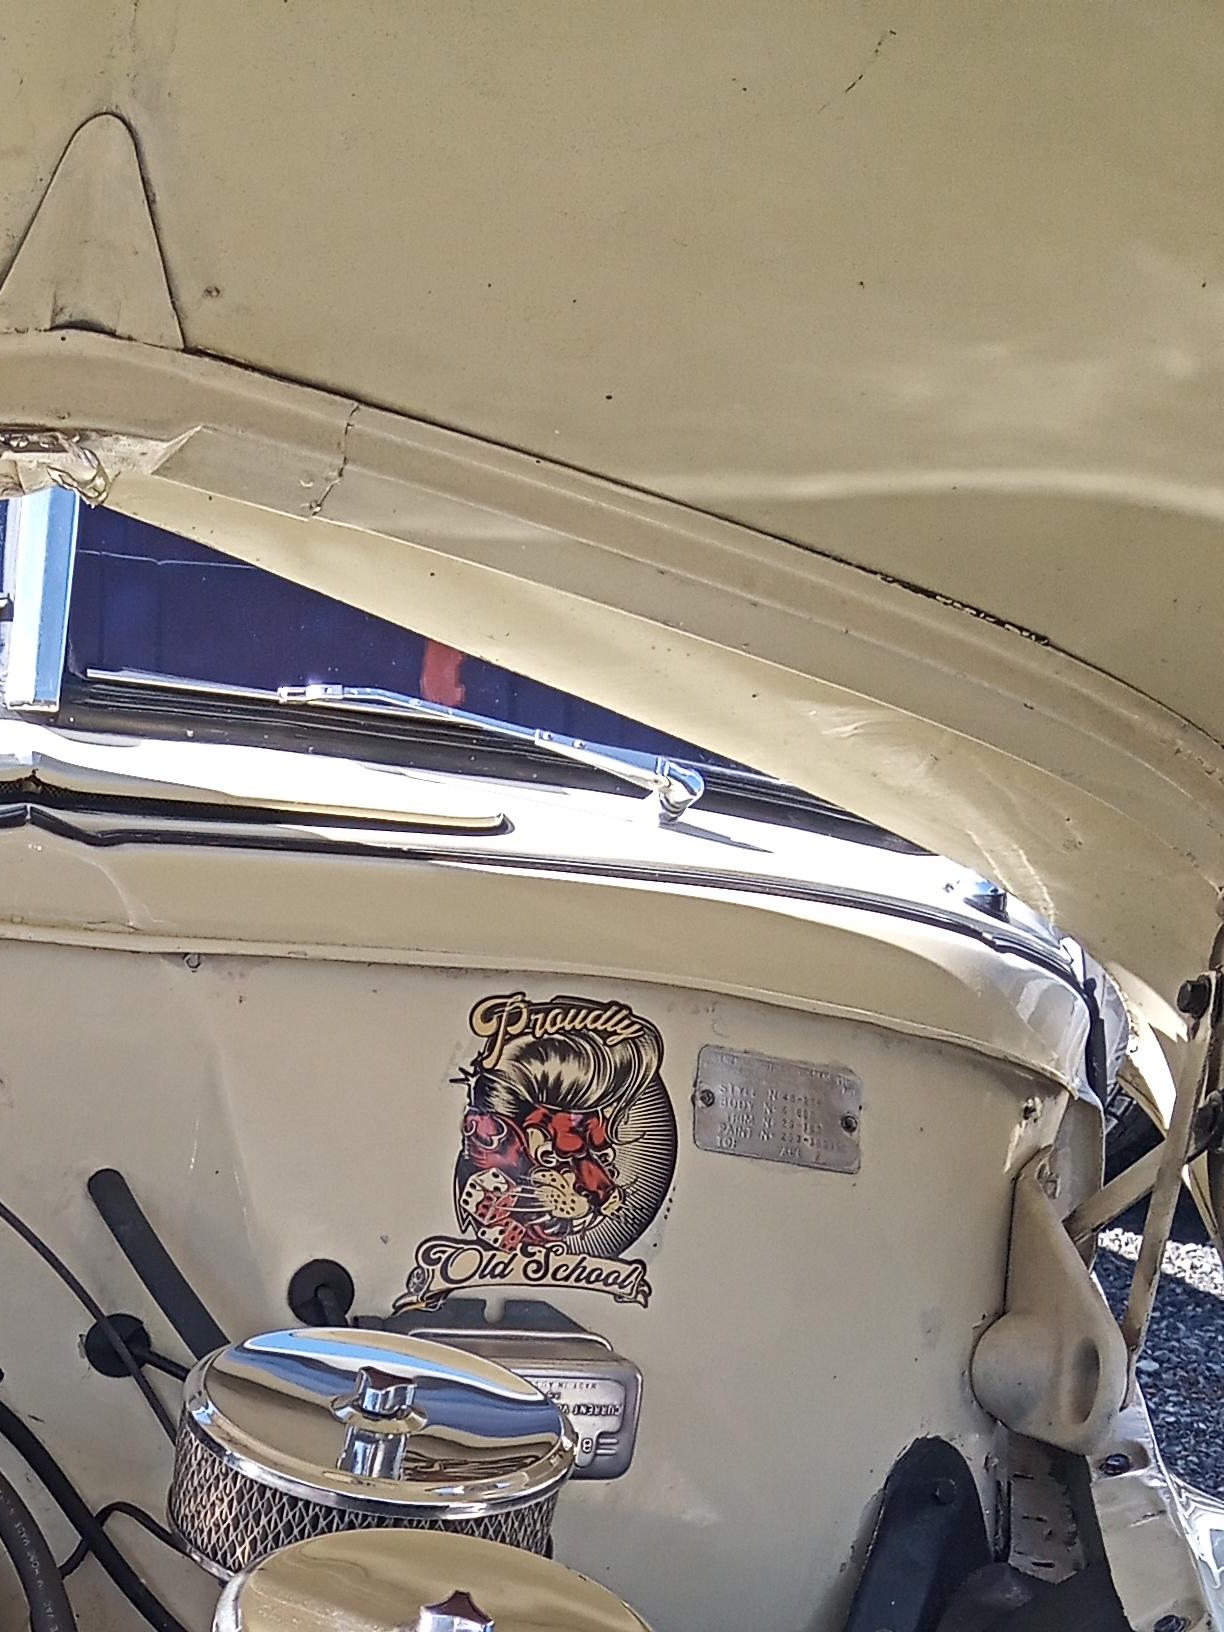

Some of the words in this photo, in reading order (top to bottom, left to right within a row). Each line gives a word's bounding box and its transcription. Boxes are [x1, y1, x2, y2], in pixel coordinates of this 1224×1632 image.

[469, 993, 645, 1069] Proudly
[423, 1246, 516, 1282] Old
[520, 1243, 642, 1292] School
[573, 1404, 623, 1415] CURRENT
